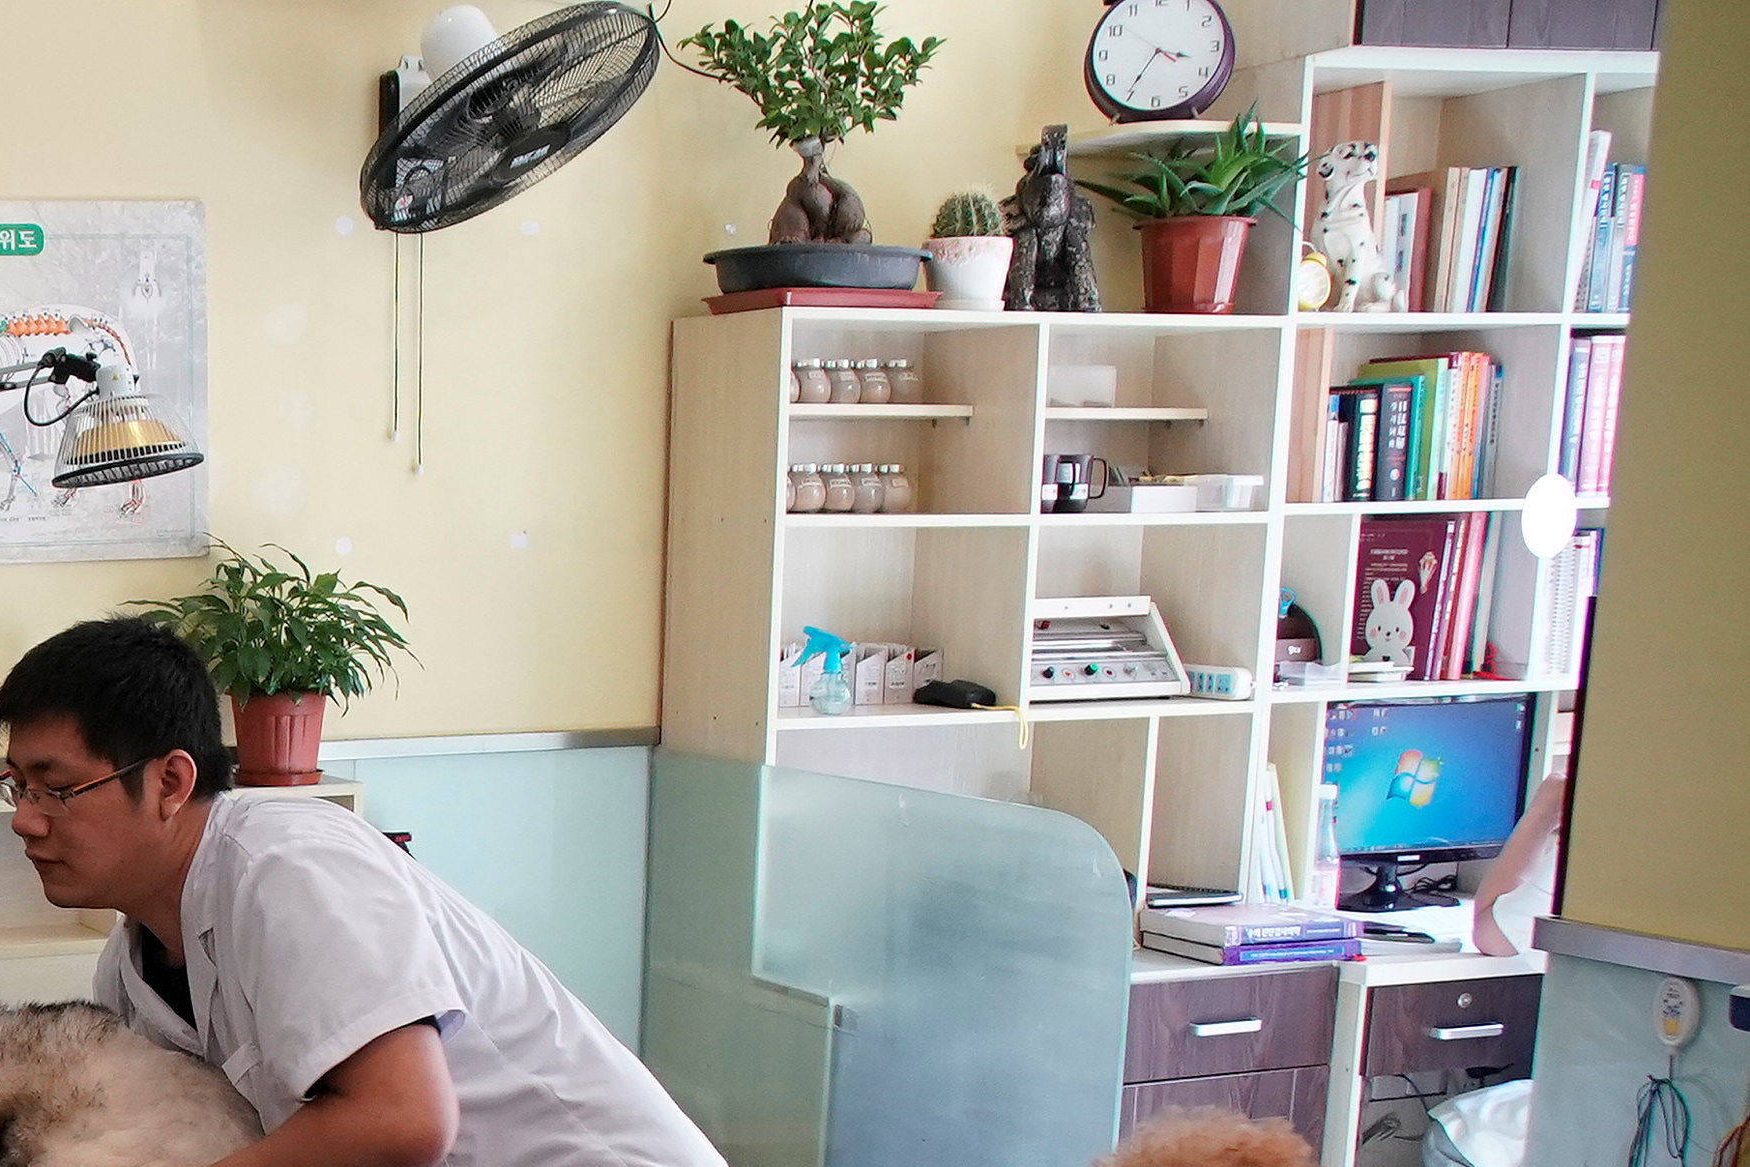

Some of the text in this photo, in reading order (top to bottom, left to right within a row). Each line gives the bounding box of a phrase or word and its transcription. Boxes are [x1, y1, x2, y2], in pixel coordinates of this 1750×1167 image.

[1128, 4, 1139, 17] 11
[1201, 15, 1213, 28] 2
[1108, 25, 1124, 38] 10
[1209, 40, 1220, 53] 3
[1098, 49, 1109, 62] 9
[1198, 66, 1209, 79] 4
[1105, 74, 1116, 86] 8
[1177, 85, 1189, 99] 5
[1150, 95, 1161, 108] 6
